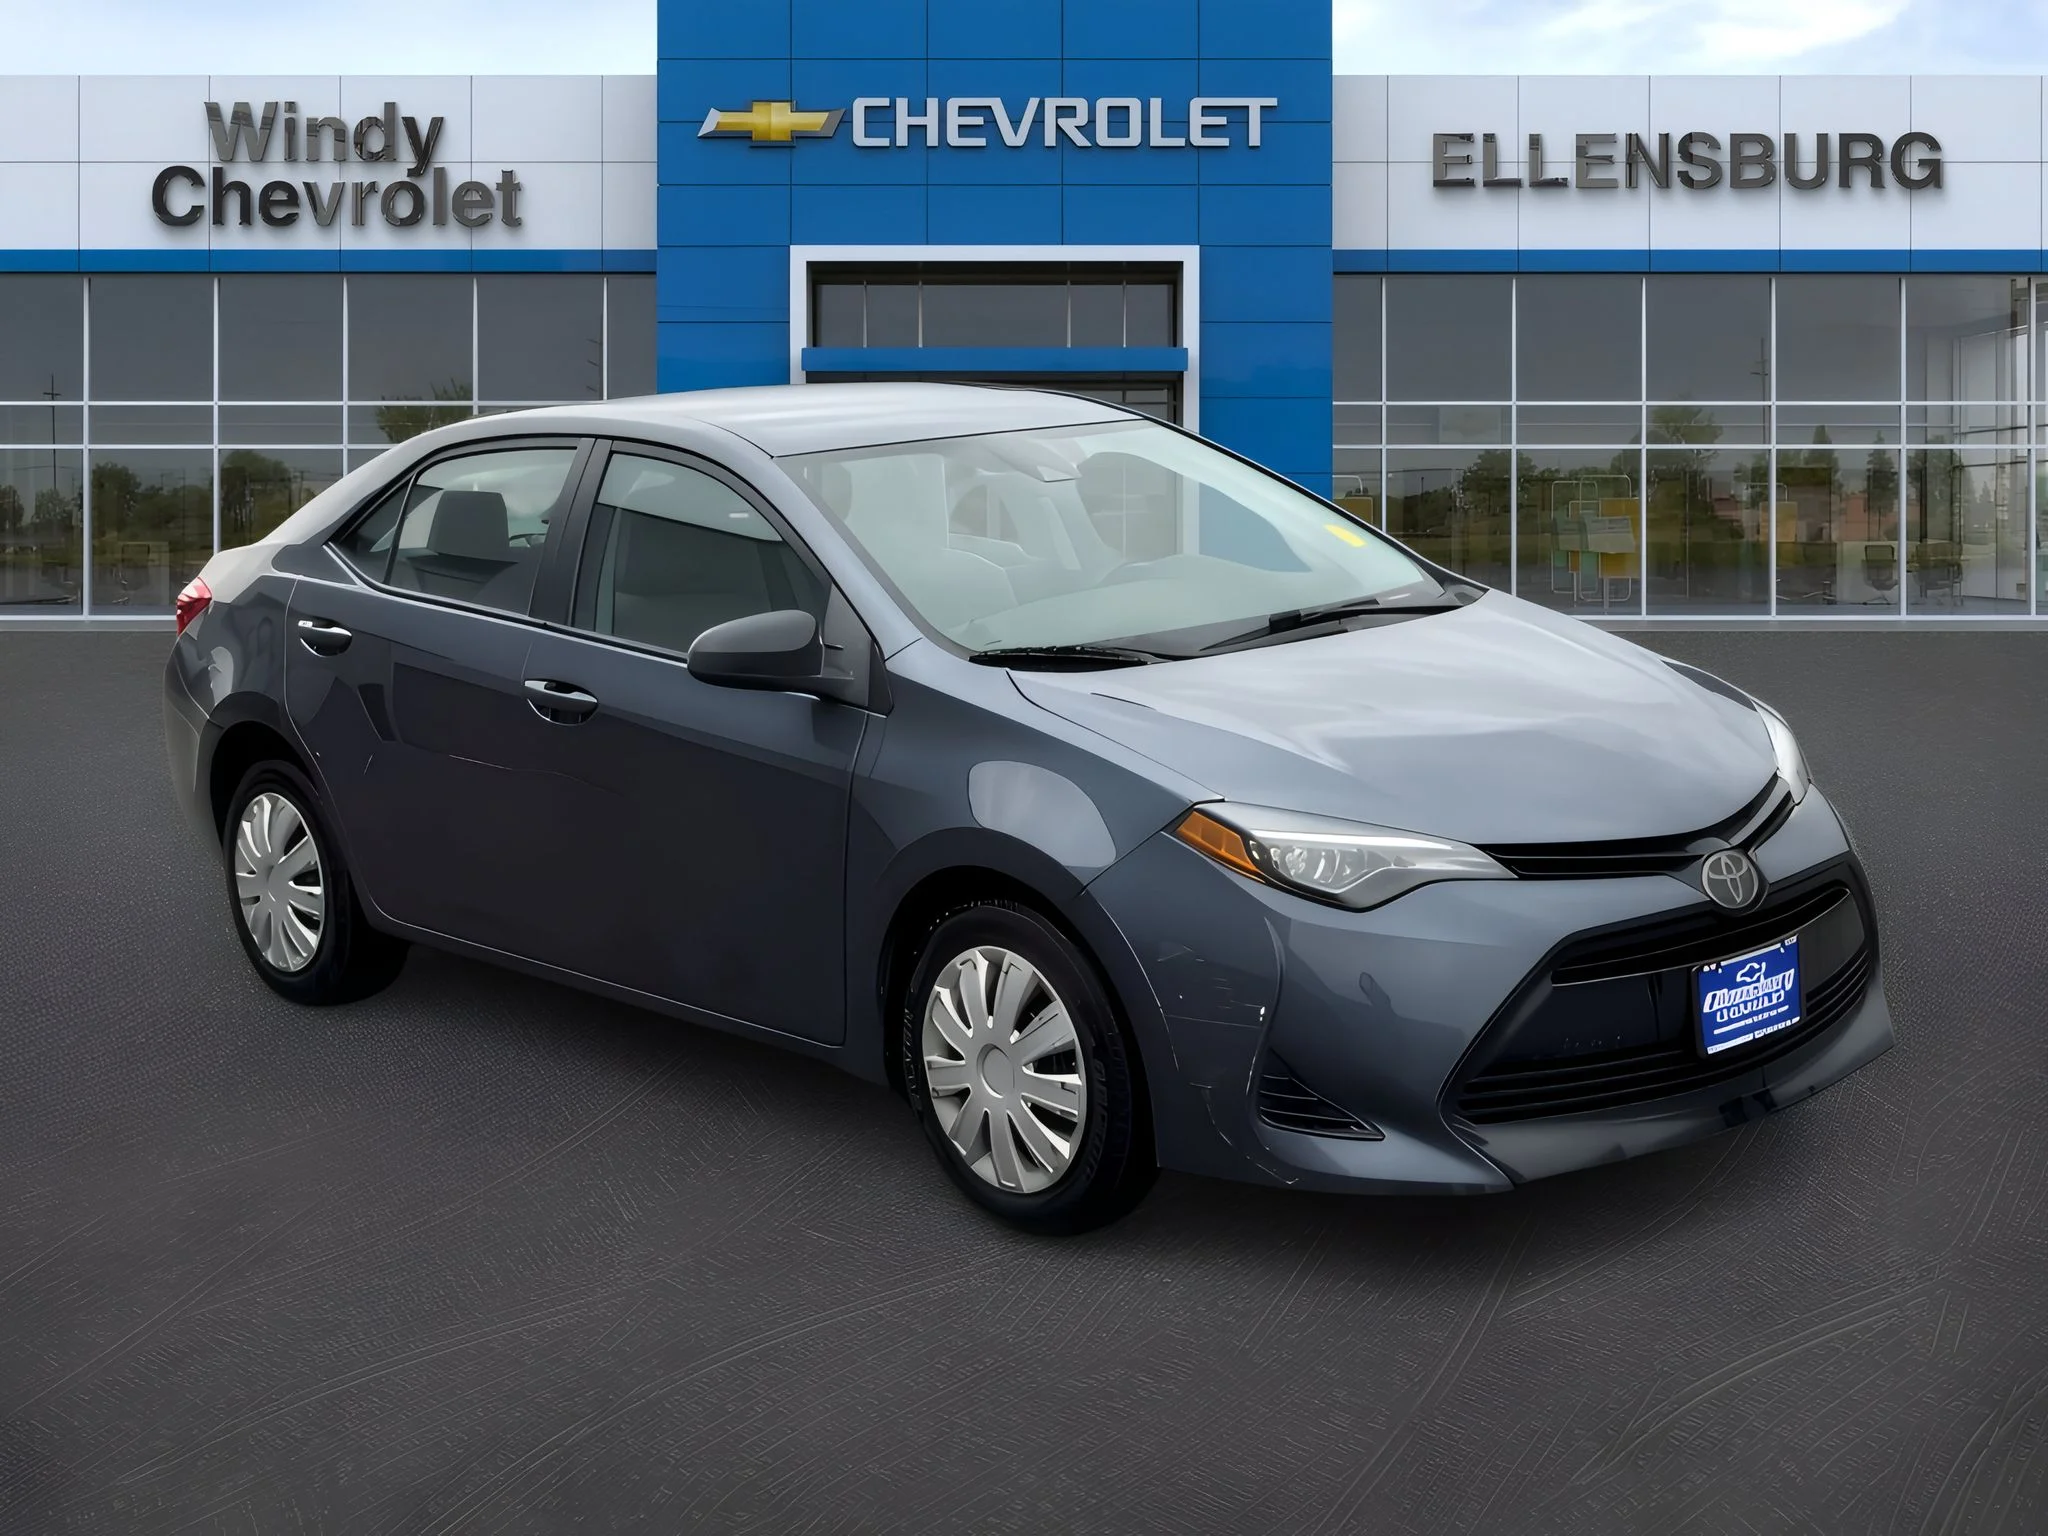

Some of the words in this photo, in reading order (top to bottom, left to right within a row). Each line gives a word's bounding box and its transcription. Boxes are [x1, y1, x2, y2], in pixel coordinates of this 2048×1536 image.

[205, 101, 444, 176] Windy
[852, 97, 1278, 147] CHEVROLET
[1433, 132, 1942, 189] ELLENSBURG
[152, 166, 523, 226] Chevrolet
